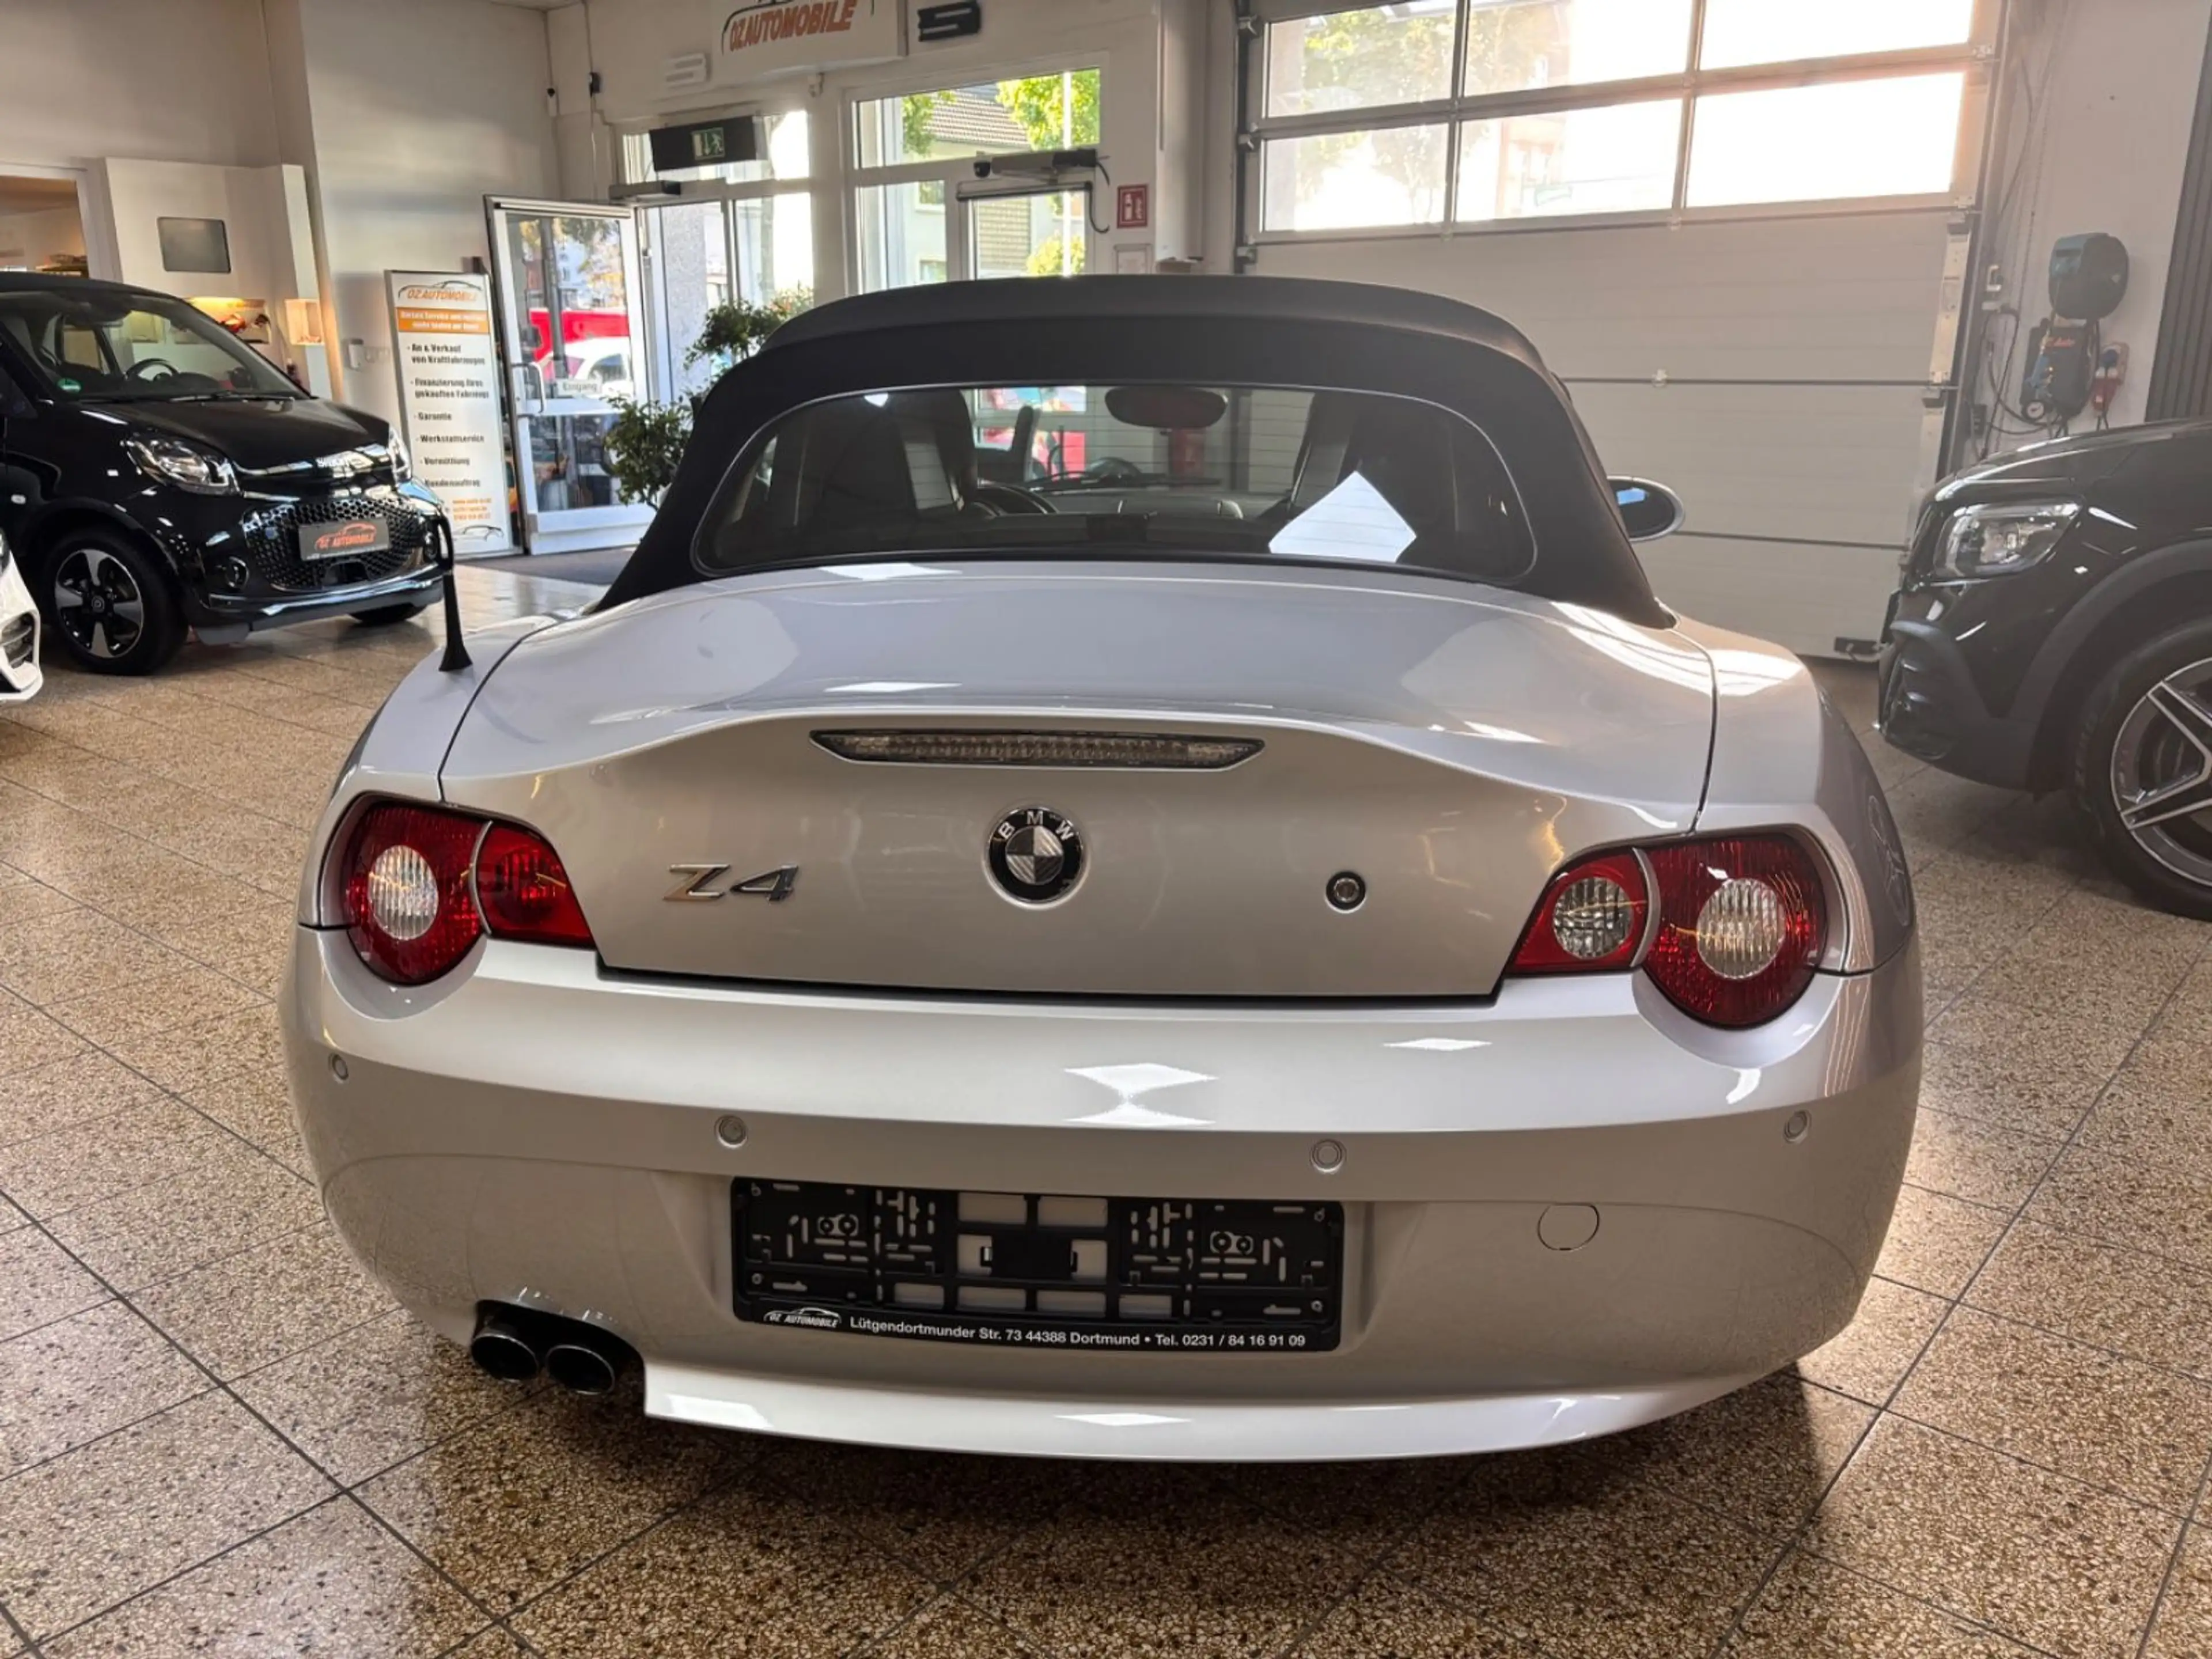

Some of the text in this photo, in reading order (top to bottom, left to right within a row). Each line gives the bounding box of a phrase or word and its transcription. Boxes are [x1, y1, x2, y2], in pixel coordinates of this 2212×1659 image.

[997, 810, 1074, 841] BMW
[663, 864, 799, 902] Z4
[850, 1316, 975, 1338] Lütgendortmunder
[979, 1327, 1002, 1340] Str.
[1006, 1329, 1022, 1341] 73
[1025, 1330, 1066, 1343] 44388
[1070, 1331, 1140, 1345] Dortmund
[1155, 1334, 1179, 1346] Tel.
[1182, 1334, 1214, 1346] 0231
[1228, 1335, 1245, 1346] 84
[1249, 1335, 1265, 1346] 16
[1268, 1335, 1284, 1346] 91
[1289, 1335, 1306, 1346] 09
